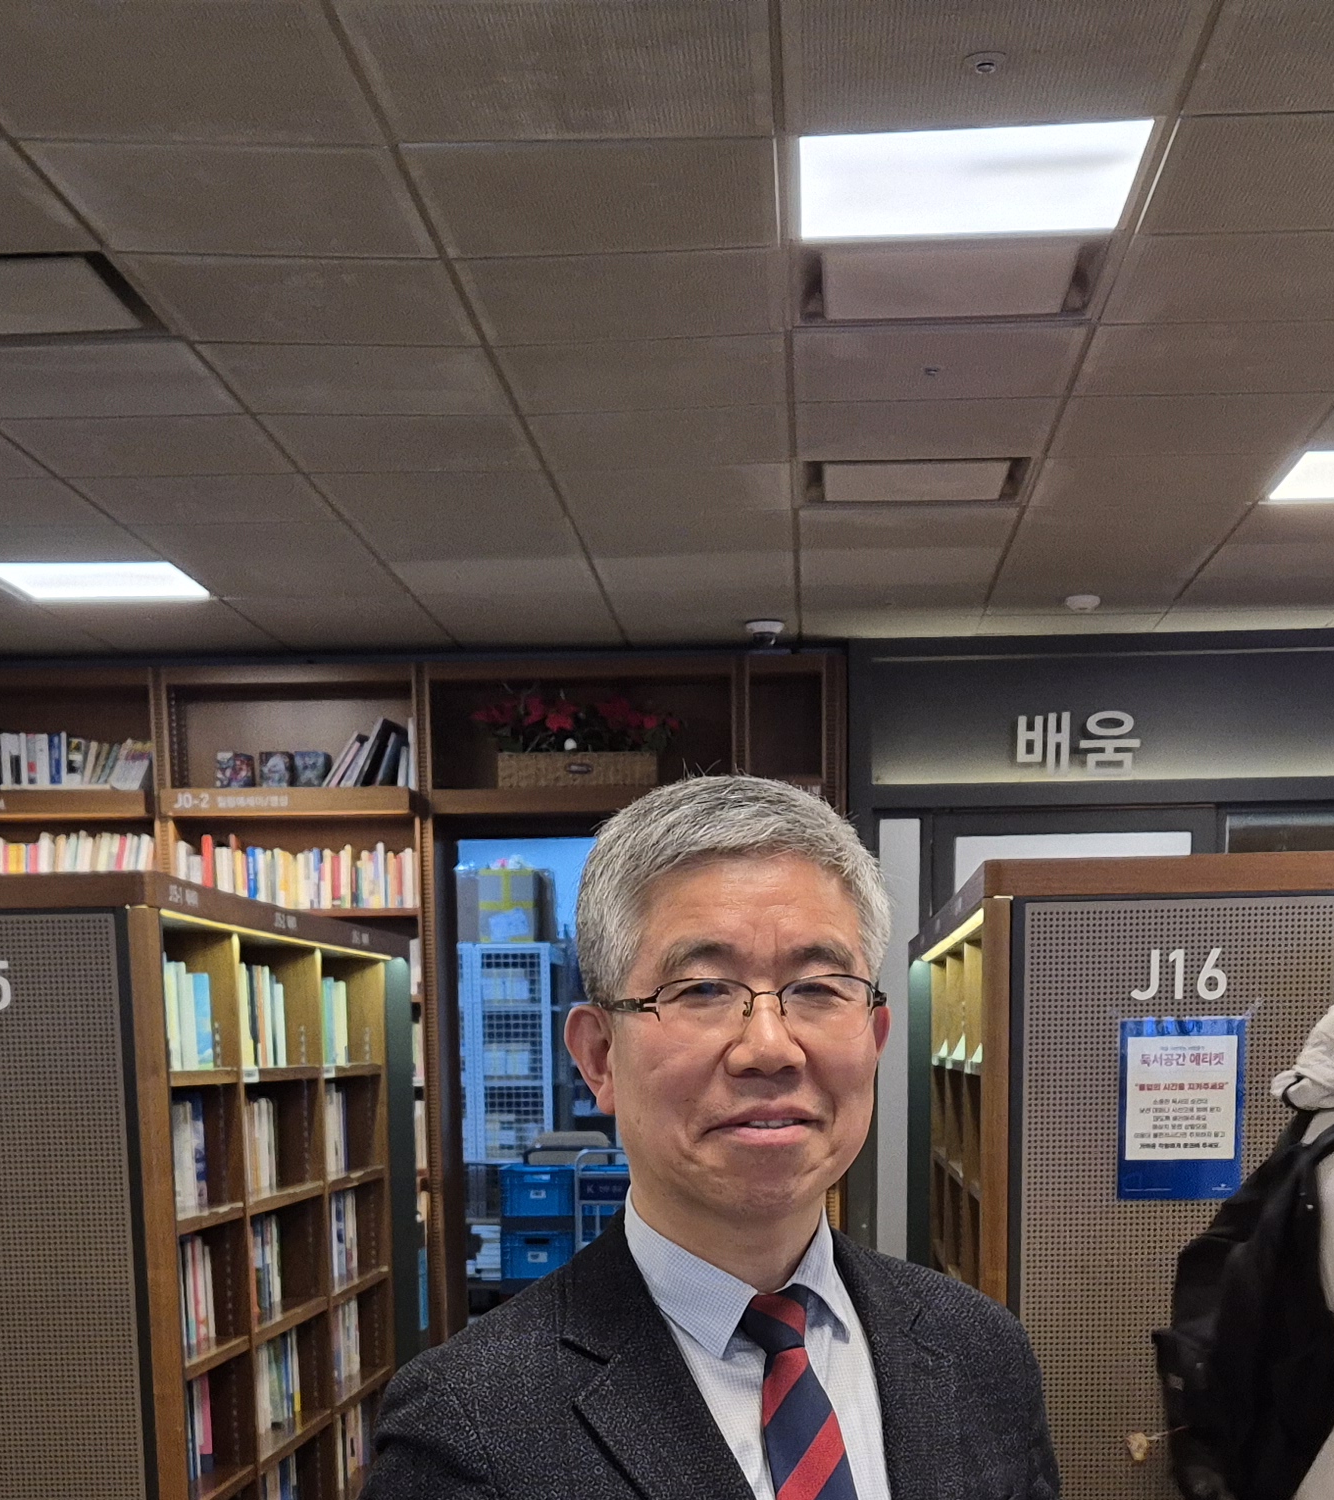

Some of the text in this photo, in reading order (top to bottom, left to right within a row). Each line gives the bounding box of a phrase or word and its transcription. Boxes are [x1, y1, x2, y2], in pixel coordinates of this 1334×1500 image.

[1016, 710, 1141, 776] 배움
[1130, 946, 1228, 1001] J16
[1140, 1052, 1224, 1067] 독서공간 에티켓
